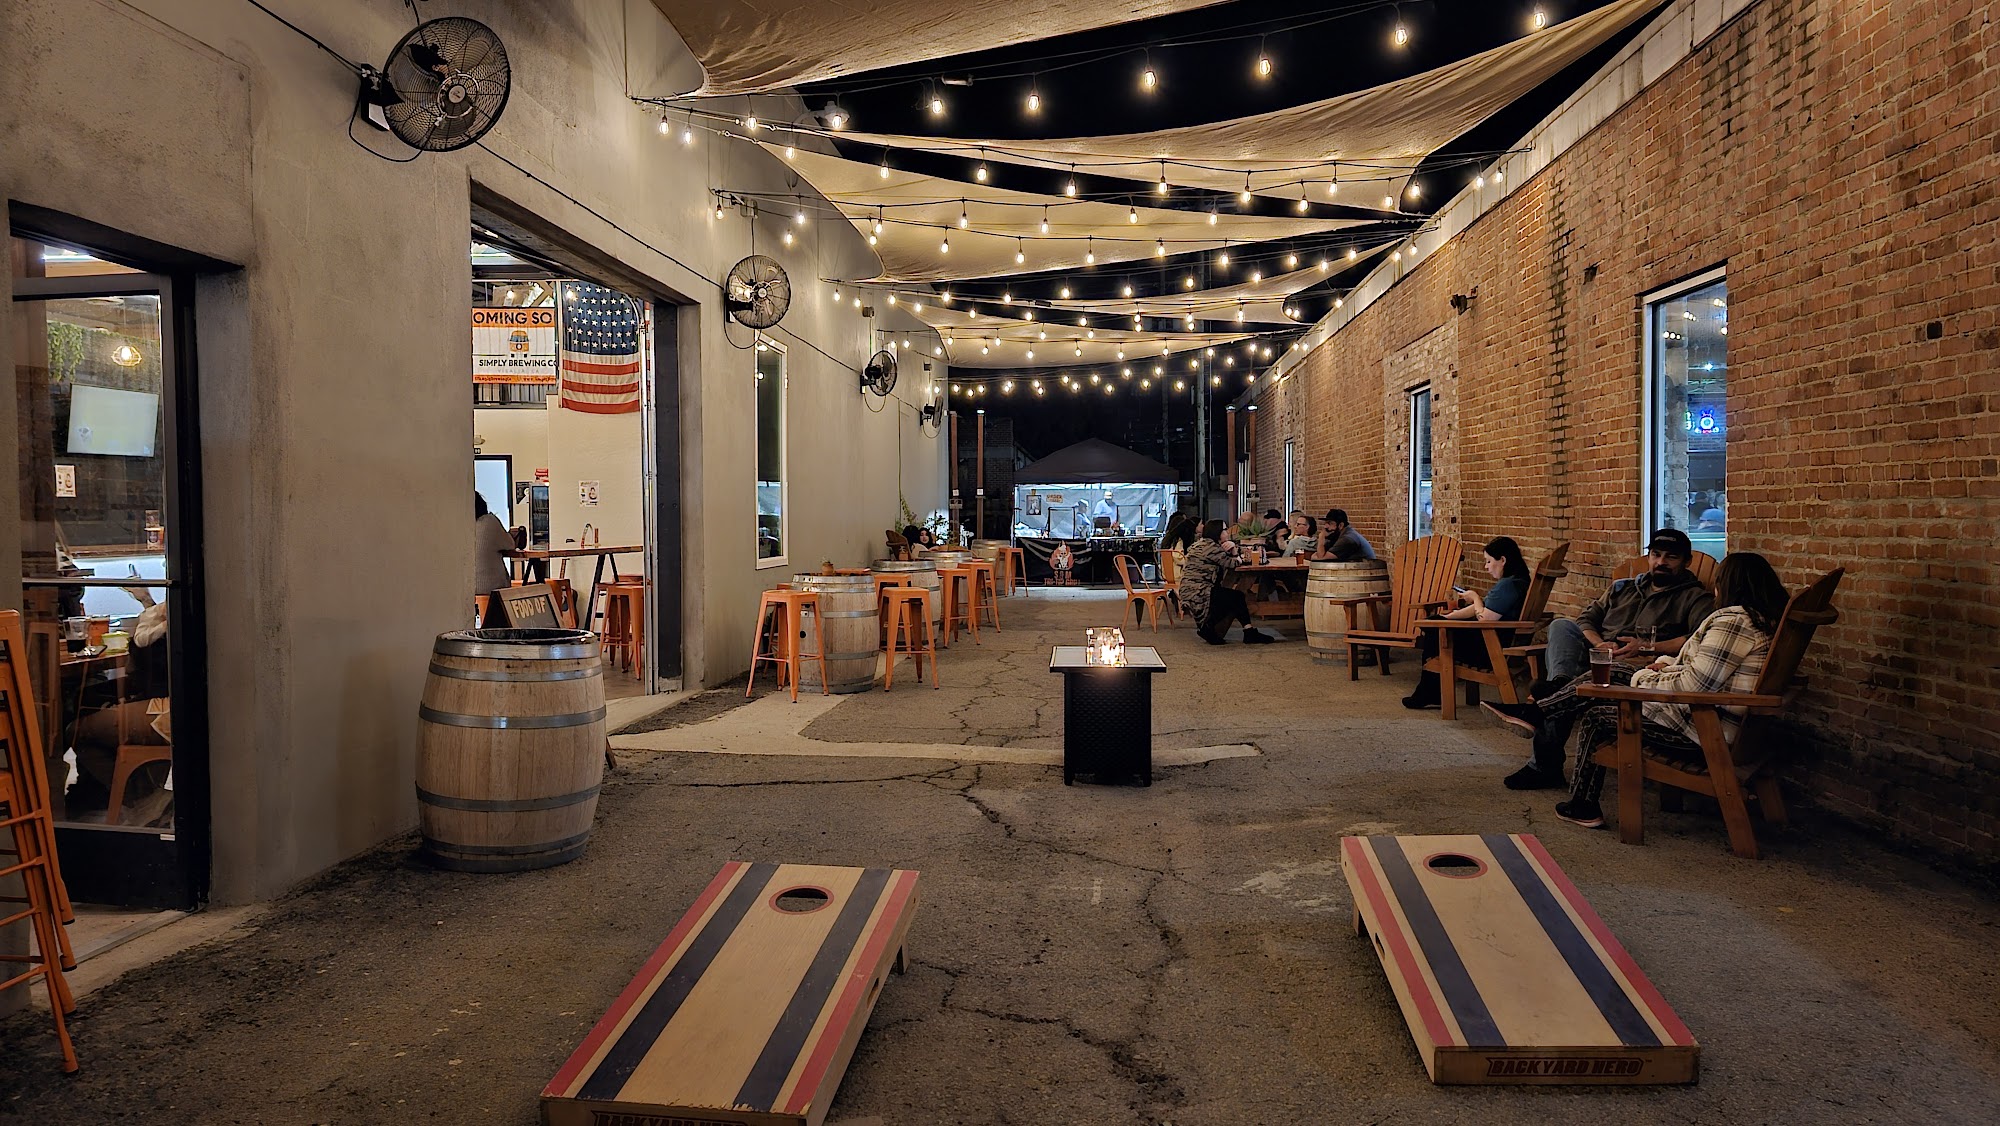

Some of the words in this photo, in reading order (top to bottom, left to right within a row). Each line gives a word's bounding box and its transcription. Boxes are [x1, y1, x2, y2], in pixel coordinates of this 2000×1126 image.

[511, 599, 535, 618] FOOD
[1491, 1060, 1589, 1073] BACKYARD
[1592, 1060, 1641, 1073] HERO
